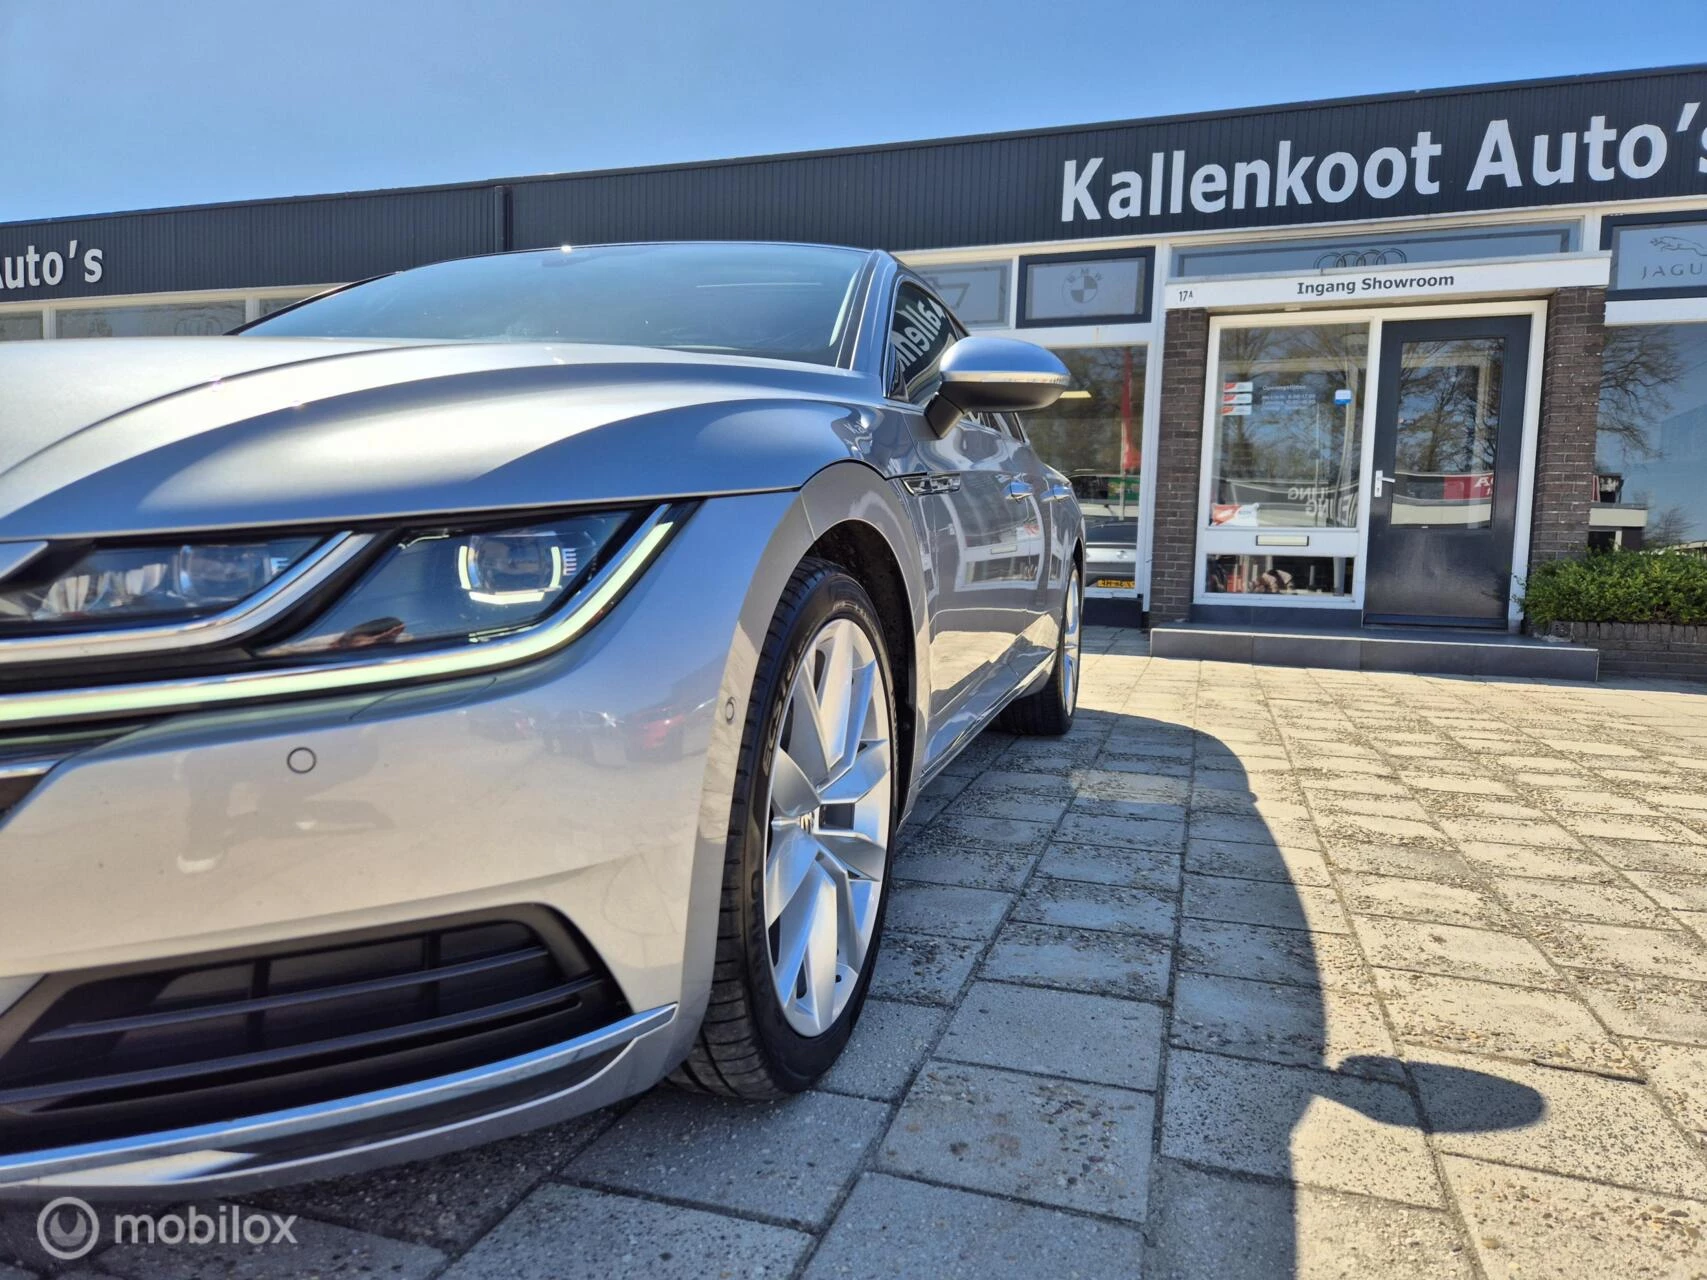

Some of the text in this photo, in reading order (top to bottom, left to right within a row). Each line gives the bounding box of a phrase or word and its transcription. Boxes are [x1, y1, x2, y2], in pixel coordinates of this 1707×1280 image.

[1061, 103, 1707, 222] Kallenkoot Auto'
[0, 239, 103, 290] uto's
[1296, 274, 1455, 297] Ingang Showroom
